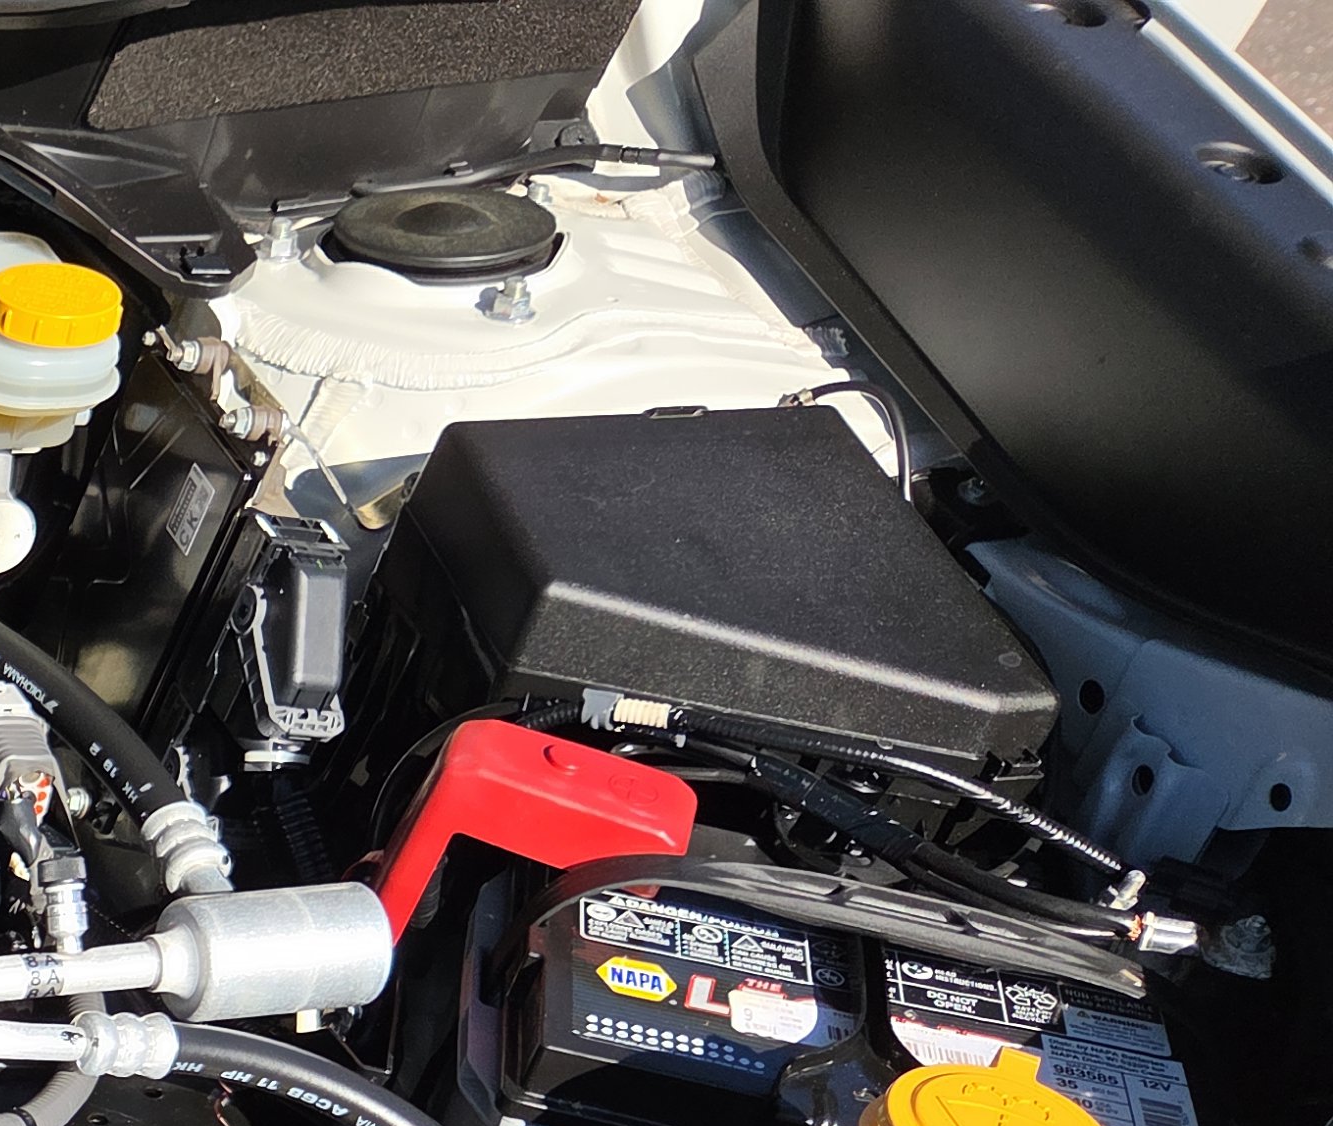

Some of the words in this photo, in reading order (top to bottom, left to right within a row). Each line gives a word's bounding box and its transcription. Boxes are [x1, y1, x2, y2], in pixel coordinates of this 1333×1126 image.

[3, 663, 49, 706] YOKOHAMA
[610, 966, 663, 993] NAPA
[744, 977, 783, 993] THE
[926, 990, 945, 1002] DO
[948, 993, 978, 1008] NOT
[934, 999, 977, 1014] OPEN.
[172, 1062, 204, 1073] HK
[1053, 1063, 1119, 1086] 983585
[220, 1070, 253, 1082] HP
[1055, 1077, 1079, 1090] 35
[256, 1078, 279, 1091] 11
[1139, 1079, 1171, 1092] 12V
